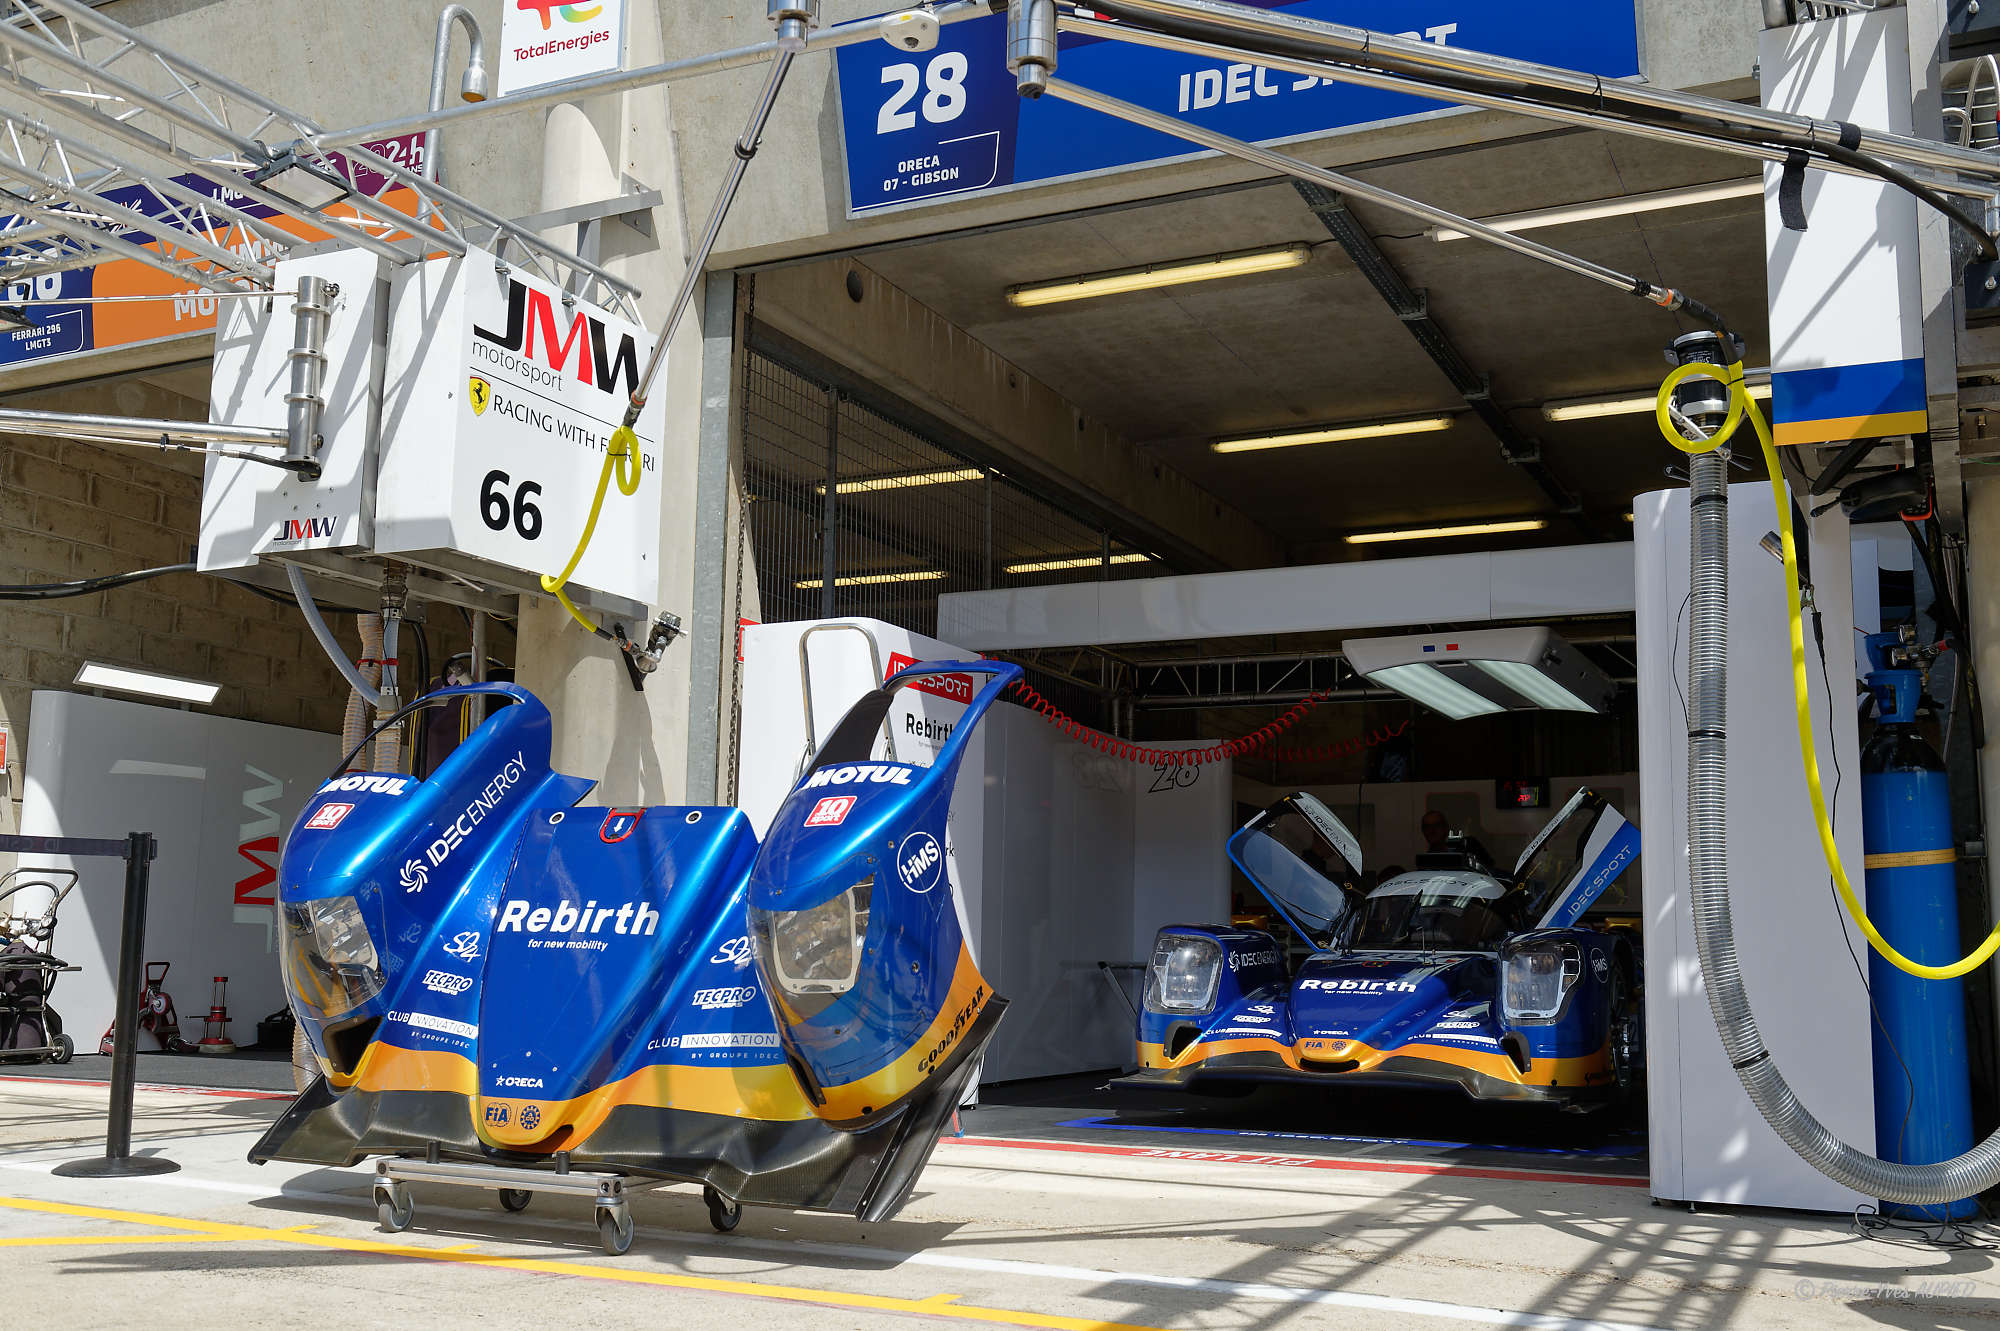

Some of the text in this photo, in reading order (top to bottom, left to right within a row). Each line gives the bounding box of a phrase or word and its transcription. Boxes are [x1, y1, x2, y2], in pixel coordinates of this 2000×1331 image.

[513, 30, 610, 61] TotalEnergies
[876, 51, 968, 135] 28
[1178, 62, 1278, 112] IDEC
[897, 154, 940, 173] ORECA
[883, 178, 899, 192] 07
[911, 167, 959, 186] GIBSON
[11, 323, 61, 342] FERRARI 296
[25, 337, 51, 350] LMGT3
[473, 278, 656, 401] JMW
[472, 340, 563, 392] motorsport
[493, 394, 552, 433] RACING
[557, 419, 595, 450] WITH
[480, 469, 543, 541] 66
[273, 516, 337, 541] JMW
[316, 775, 409, 796] MOTUL
[799, 765, 913, 791] MOTUL
[900, 841, 939, 885] HMS
[1568, 844, 1631, 917] IDEC SPORT
[497, 899, 660, 935] Rebirth
[527, 938, 608, 952] for new mobility
[422, 969, 473, 991] TECPRO
[1299, 979, 1417, 993] Rebirth
[692, 986, 757, 1006] TECPRO
[387, 1011, 474, 1036] CLUB INNOVATION
[648, 1034, 776, 1050] CLUB INNOVATION
[505, 1076, 544, 1089] ORECA
